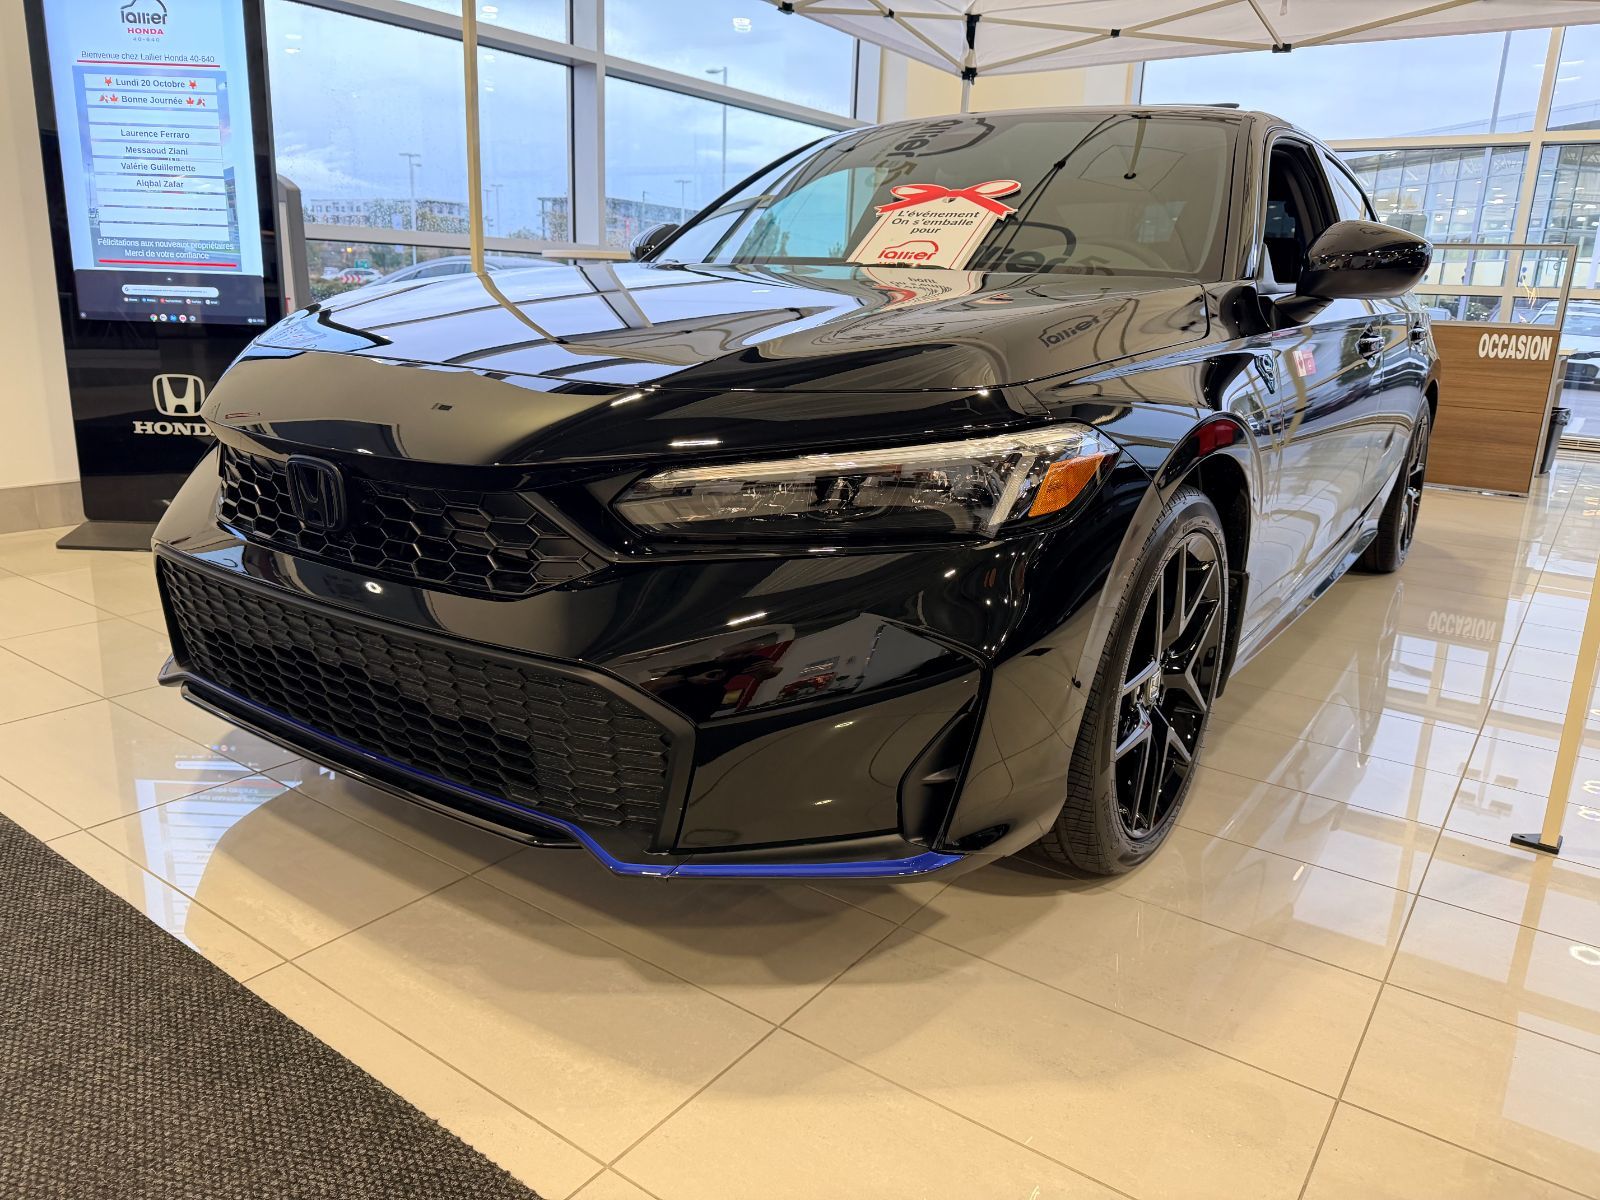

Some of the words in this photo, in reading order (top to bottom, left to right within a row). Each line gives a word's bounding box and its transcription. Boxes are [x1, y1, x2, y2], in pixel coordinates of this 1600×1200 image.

[120, 10, 167, 24] lallier
[127, 27, 164, 35] HONDA
[81, 51, 119, 60] Bienvenue
[121, 52, 138, 60] chez
[164, 54, 188, 62] Honda
[190, 55, 215, 63] 40-640
[116, 78, 139, 87] Lundi
[141, 79, 151, 88] 20
[153, 79, 185, 89] Octobre
[121, 95, 148, 103] Bonne
[150, 95, 183, 105] Journée
[121, 129, 158, 138] Laurence
[160, 130, 190, 139] Ferraro
[125, 146, 167, 155] Messaoud
[168, 147, 188, 156] Ziani
[120, 162, 148, 171] Valérie
[150, 163, 196, 173] Guillemette
[898, 210, 980, 218] L'événement
[912, 218, 974, 226] s'emballe
[97, 238, 140, 247] Félicitations
[155, 241, 189, 249] nouveaux
[190, 242, 234, 251] propriétaires
[124, 249, 144, 257] Merci
[145, 250, 156, 258] de
[176, 251, 210, 260] confiance
[877, 250, 937, 261] lallier
[1478, 333, 1553, 361] OCCASION
[132, 421, 215, 436] HOND
